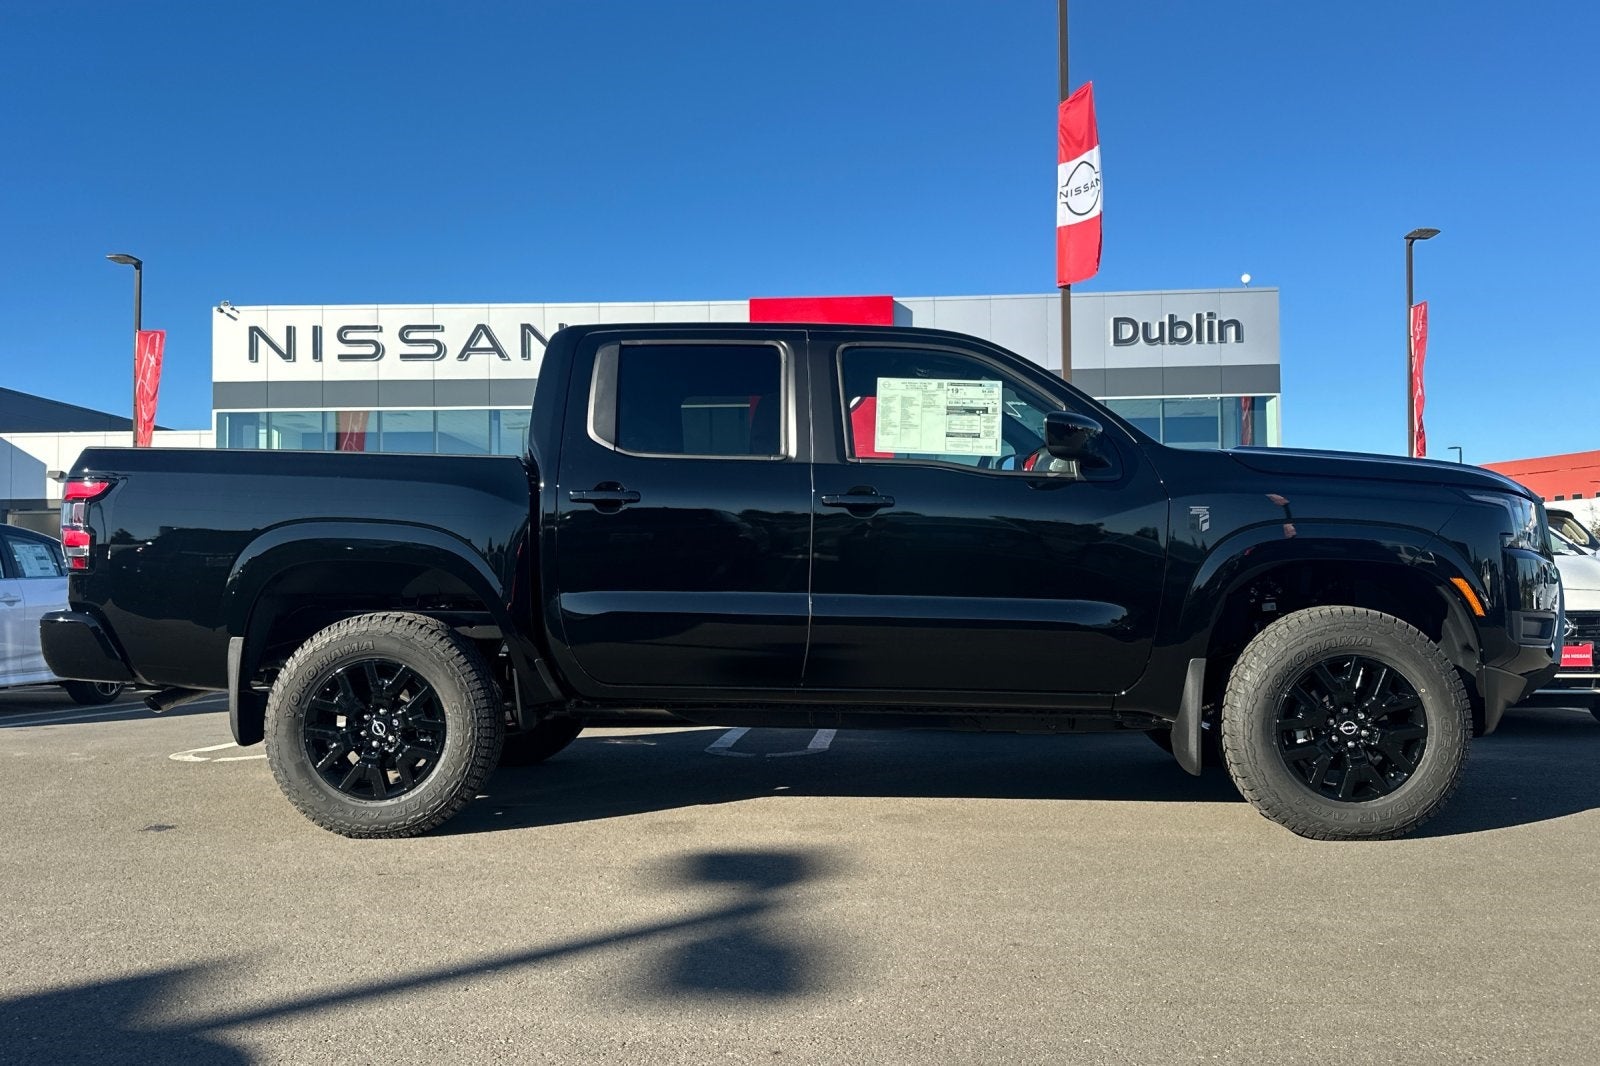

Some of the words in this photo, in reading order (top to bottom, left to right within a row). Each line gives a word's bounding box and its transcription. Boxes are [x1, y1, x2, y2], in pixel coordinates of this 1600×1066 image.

[1112, 312, 1244, 346] Dublin
[285, 640, 375, 718] YOKOHAMA
[1265, 636, 1373, 699] YOKOHAMA
[391, 701, 465, 819] GEOLANDAR
[1358, 717, 1453, 823] GEOLANDAR
